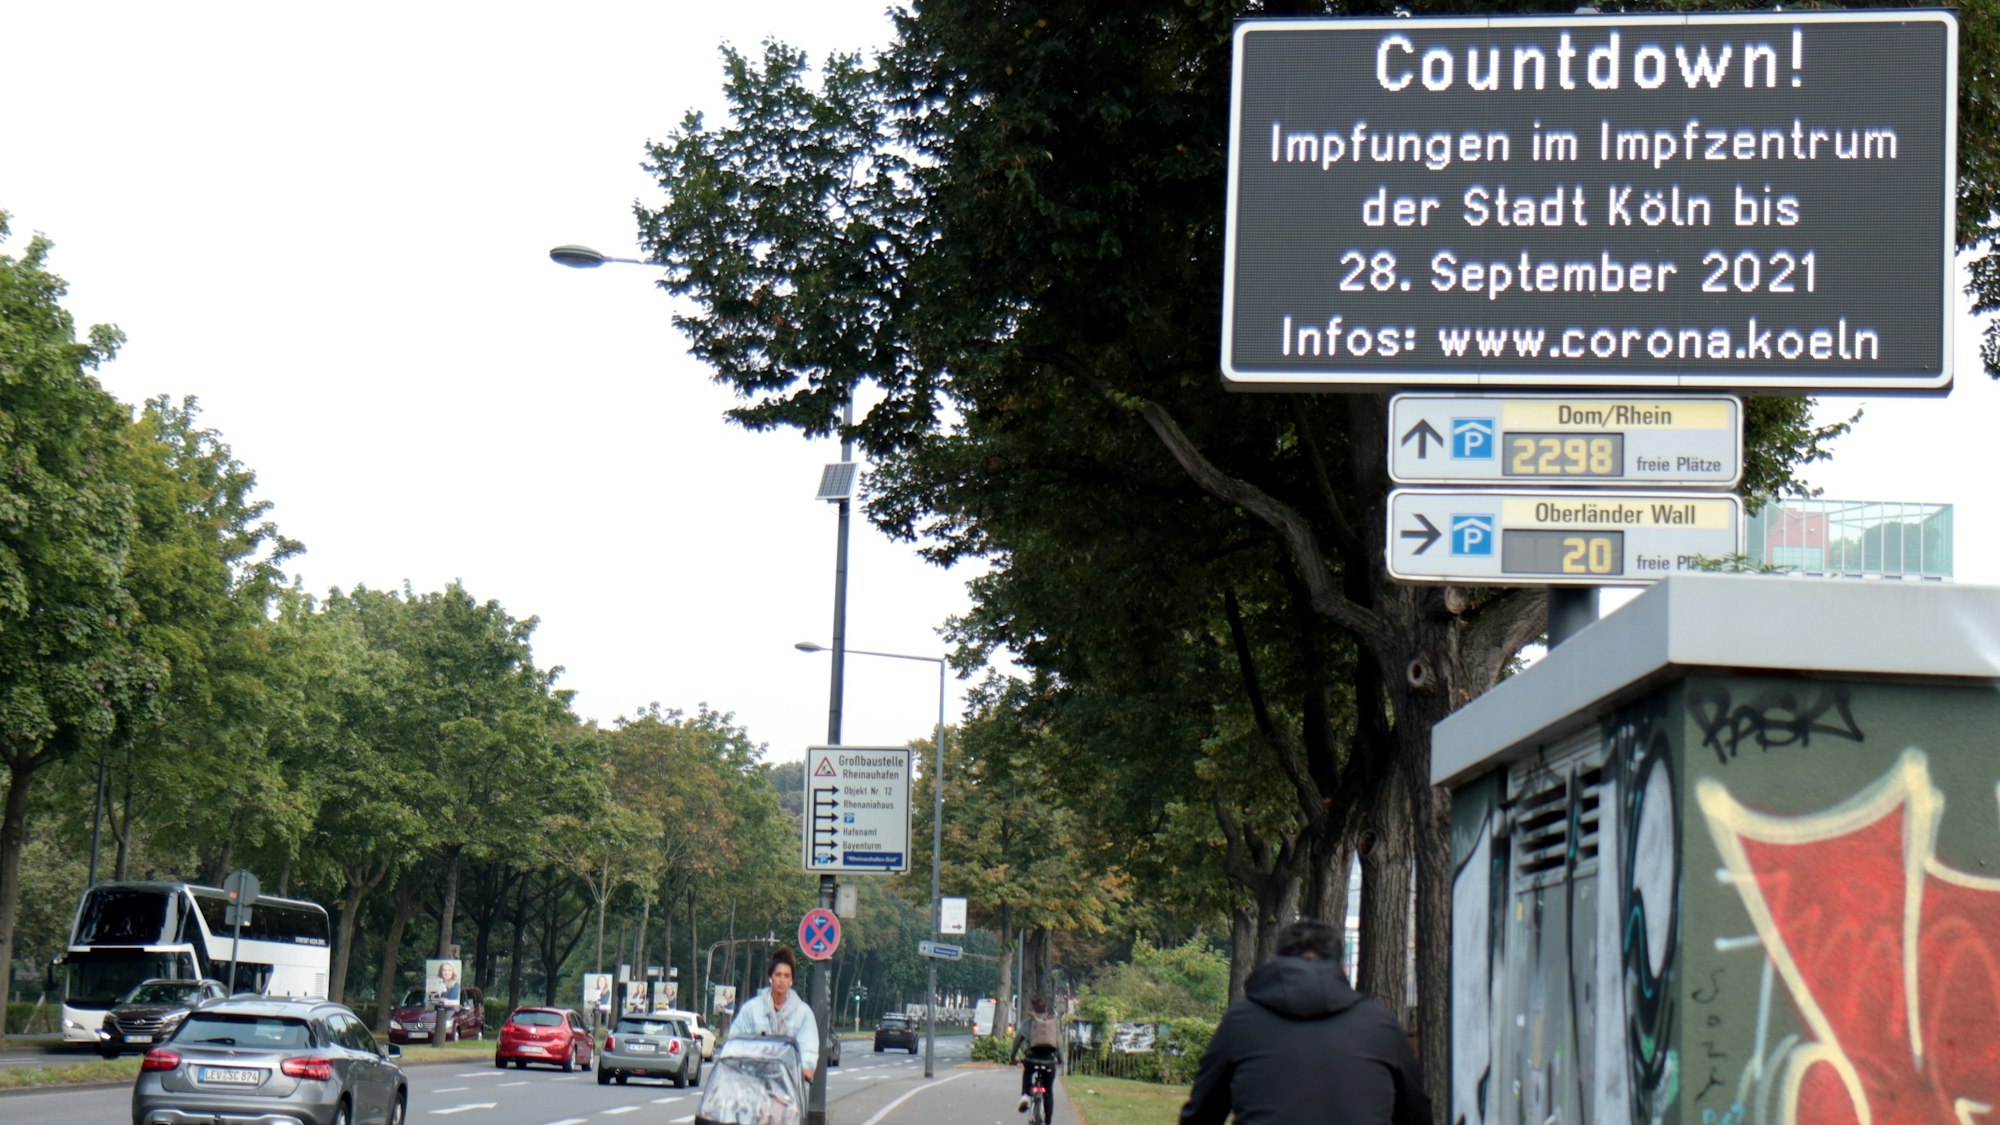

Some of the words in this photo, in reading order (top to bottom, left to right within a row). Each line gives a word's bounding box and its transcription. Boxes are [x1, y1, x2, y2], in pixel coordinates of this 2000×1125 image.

[1376, 30, 1804, 92] Countdown!
[1270, 122, 1511, 171] Impfungen
[1532, 122, 1578, 161] im
[1600, 119, 1898, 170] Impfzentrum
[1362, 187, 1440, 227] der
[1463, 186, 1588, 227] Stadt
[1608, 186, 1712, 226] Köln
[1734, 186, 1800, 226] bis
[1339, 251, 1412, 292] 28.
[1431, 251, 1678, 300] September
[1701, 251, 1816, 293] 2021
[1282, 316, 1417, 358] Infos:
[1438, 318, 1879, 361] www.corona.koeln
[1557, 405, 1673, 427] Dom/Rhein
[1511, 438, 1614, 475] 2298
[1636, 456, 1671, 472] freie
[1676, 455, 1722, 473] Plätze
[1534, 502, 1644, 524] Oberländer
[1650, 504, 1696, 525] Wall
[1561, 537, 1613, 574] 20
[1636, 555, 1671, 571] freie
[838, 754, 904, 768] Großbaustelle
[842, 769, 900, 781] Rheinauhafen
[843, 786, 868, 797] Objekt
[884, 786, 893, 796] 12
[843, 799, 894, 810] Rhenaniahaus
[842, 827, 878, 837] Hafenamt
[842, 841, 882, 852] Bayenturm
[205, 1069, 223, 1080] LEV
